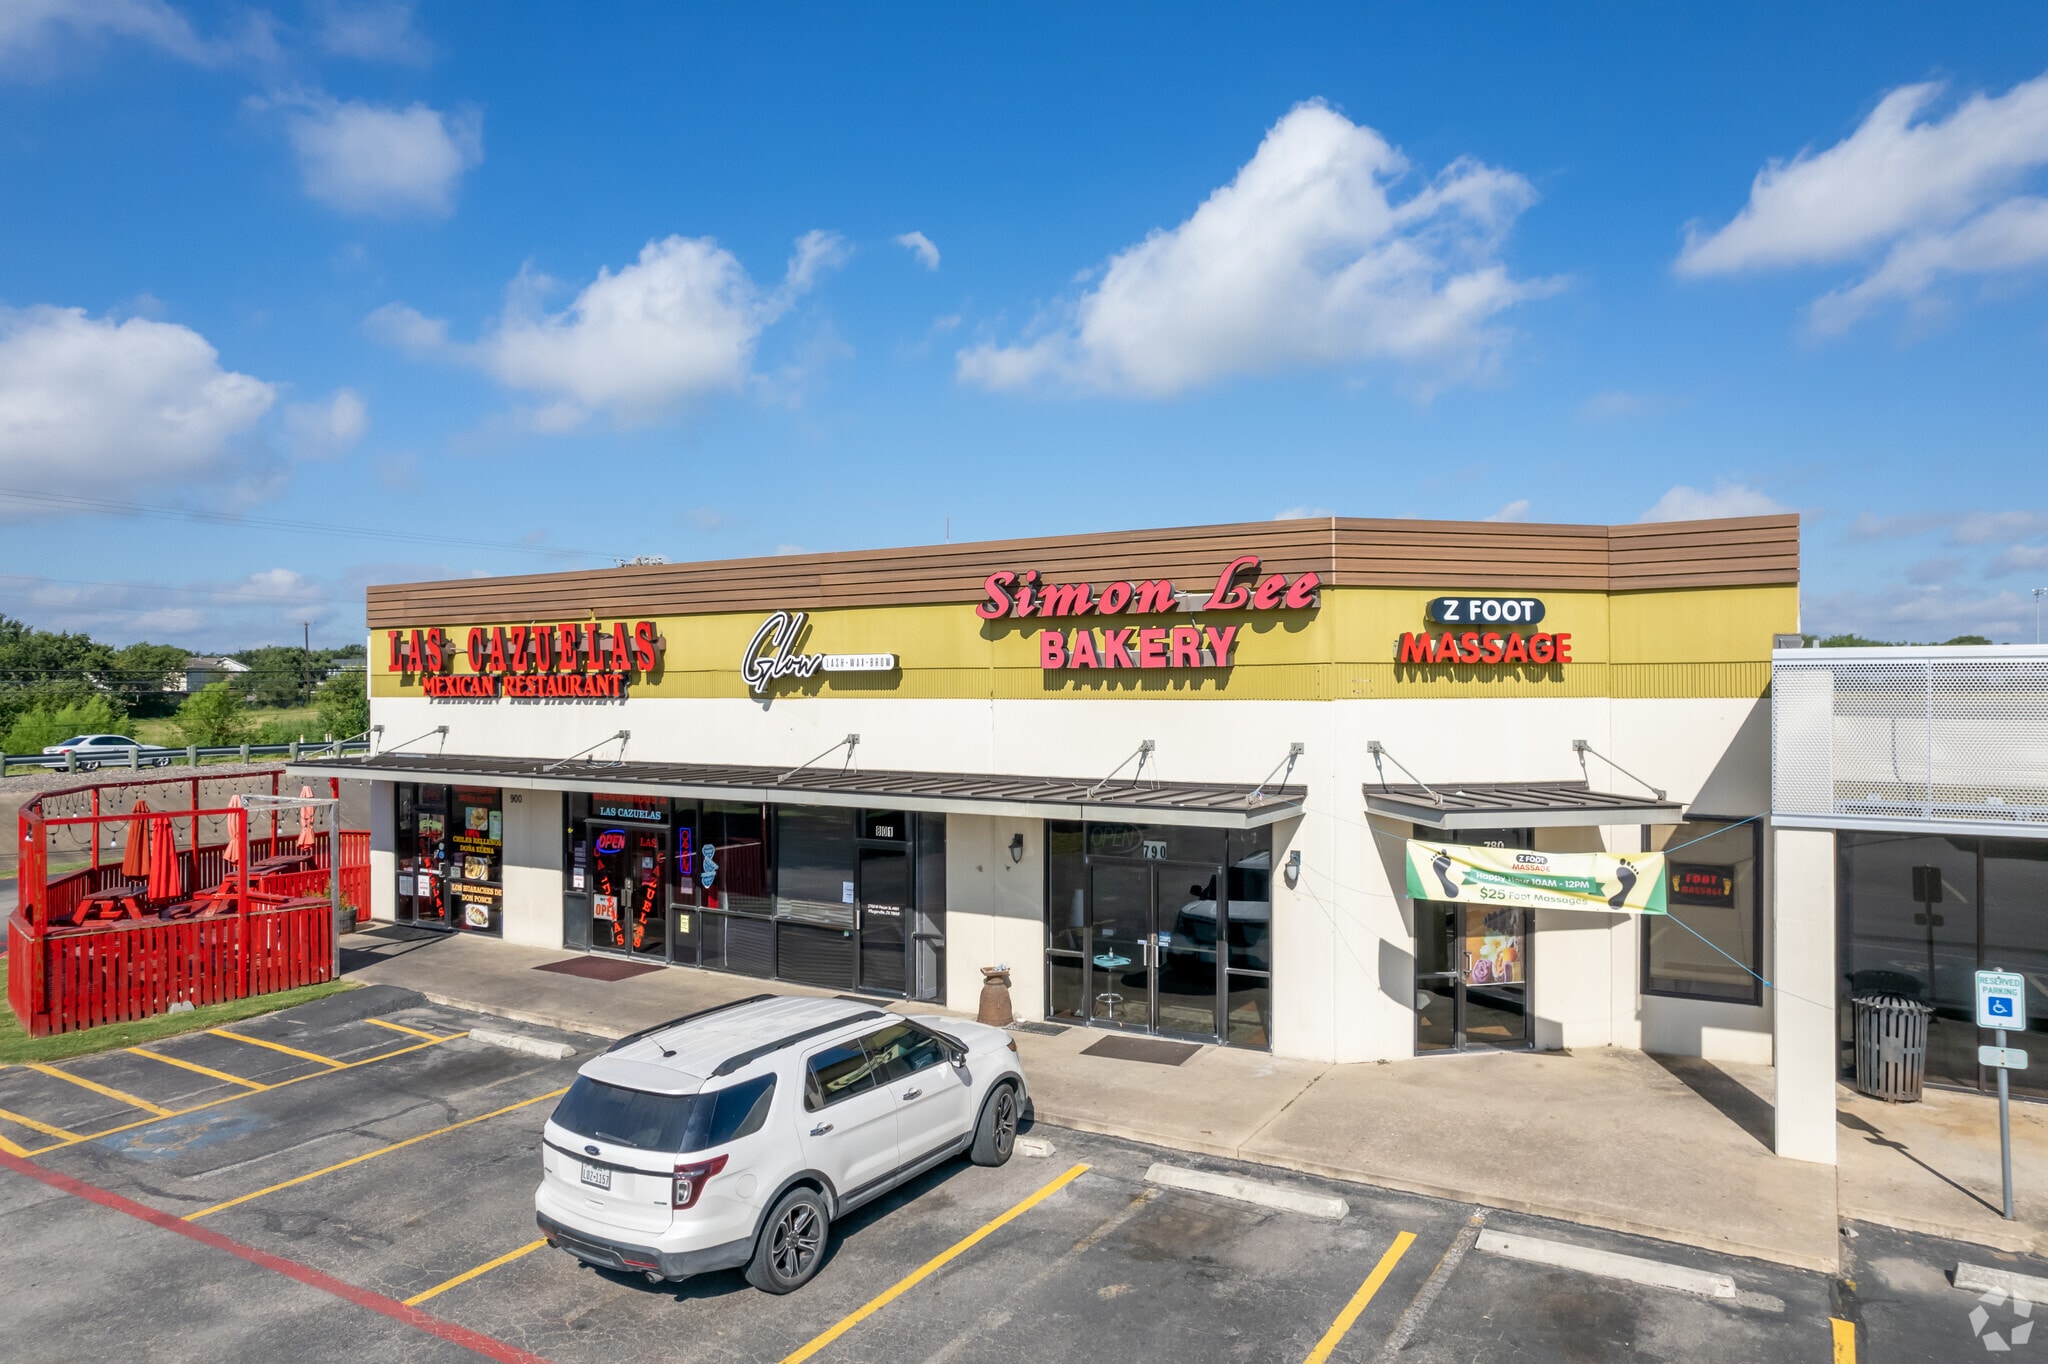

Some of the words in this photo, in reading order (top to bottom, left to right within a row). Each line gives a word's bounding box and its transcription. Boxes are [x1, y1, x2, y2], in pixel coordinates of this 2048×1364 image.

[976, 569, 1180, 620] Simon
[1203, 555, 1321, 611] Lee
[1443, 600, 1459, 621] Z
[1469, 600, 1535, 621] FOOT
[388, 627, 444, 672] LAS
[468, 621, 656, 672] CAZUELAS
[741, 611, 822, 693] Glow
[1040, 626, 1237, 669] BAKERY
[1400, 632, 1573, 664] MASSAGE
[423, 675, 495, 697] MEXICAN
[504, 673, 624, 697] RESTAURANT
[510, 794, 522, 804] 900
[600, 807, 616, 816] LAS
[618, 808, 661, 820] CAZUELAS
[875, 826, 894, 837] 801
[1091, 827, 1134, 847] OPEN
[599, 834, 625, 849] OPEN
[640, 838, 658, 847] LAS
[1144, 845, 1166, 858] 790
[1525, 855, 1546, 864] FOOT
[1512, 863, 1551, 872] MASSAGE
[1476, 872, 1506, 883] Happy
[1508, 876, 1529, 884] Hour
[1531, 878, 1557, 887] 10AM
[1564, 880, 1590, 889] 12PM
[1685, 873, 1717, 885] FOOT
[1480, 886, 1506, 900] $25
[1509, 891, 1530, 900] Foot
[1534, 894, 1588, 905] Massages
[1681, 885, 1722, 896] MASSAGE
[596, 903, 617, 918] OPE
[1979, 976, 2020, 987] RESERVED
[1982, 986, 2018, 996] PARKING
